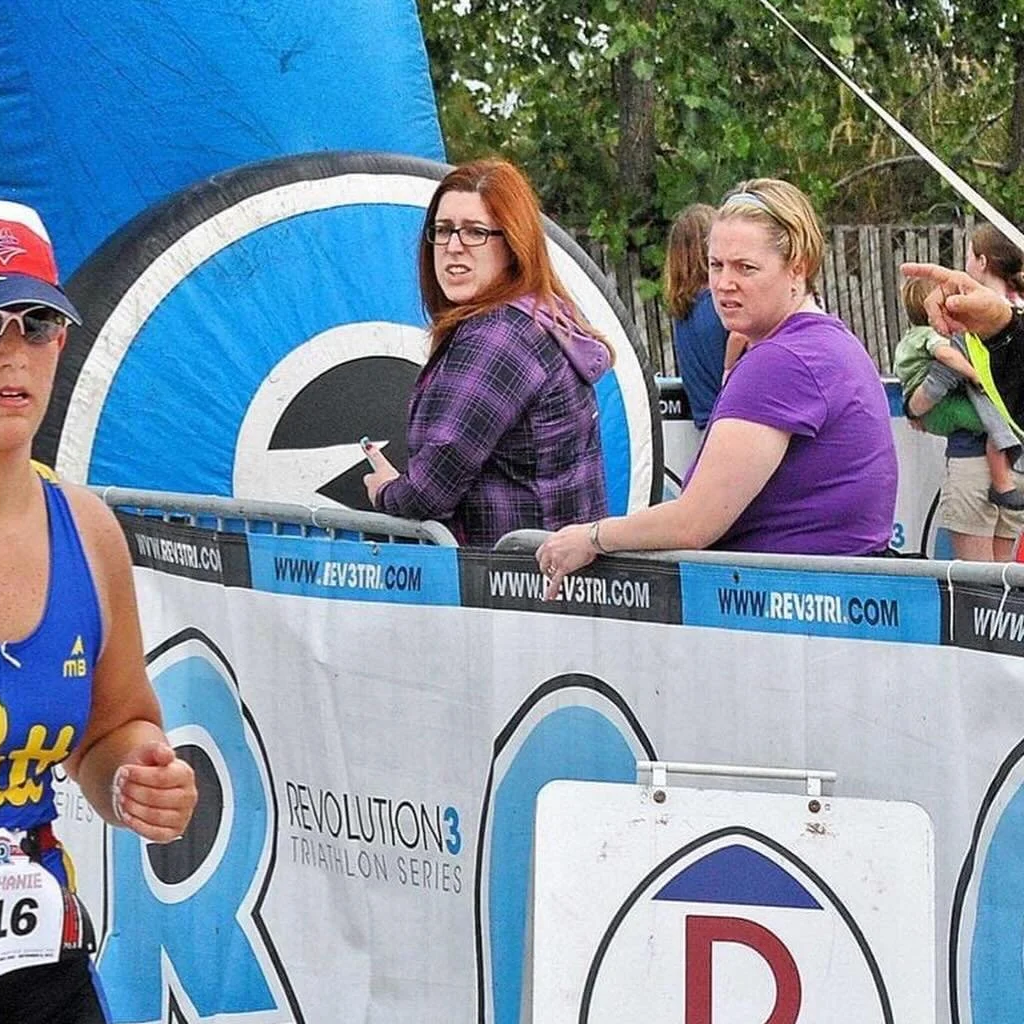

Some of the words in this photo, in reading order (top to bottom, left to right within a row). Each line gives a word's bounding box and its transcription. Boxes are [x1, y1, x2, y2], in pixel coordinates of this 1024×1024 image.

[716, 587, 900, 627] WWW.REV3TRI.COM
[285, 781, 463, 856] REVOLUTION3
[290, 836, 390, 882] TRIATHLON
[397, 857, 464, 895] SERIES
